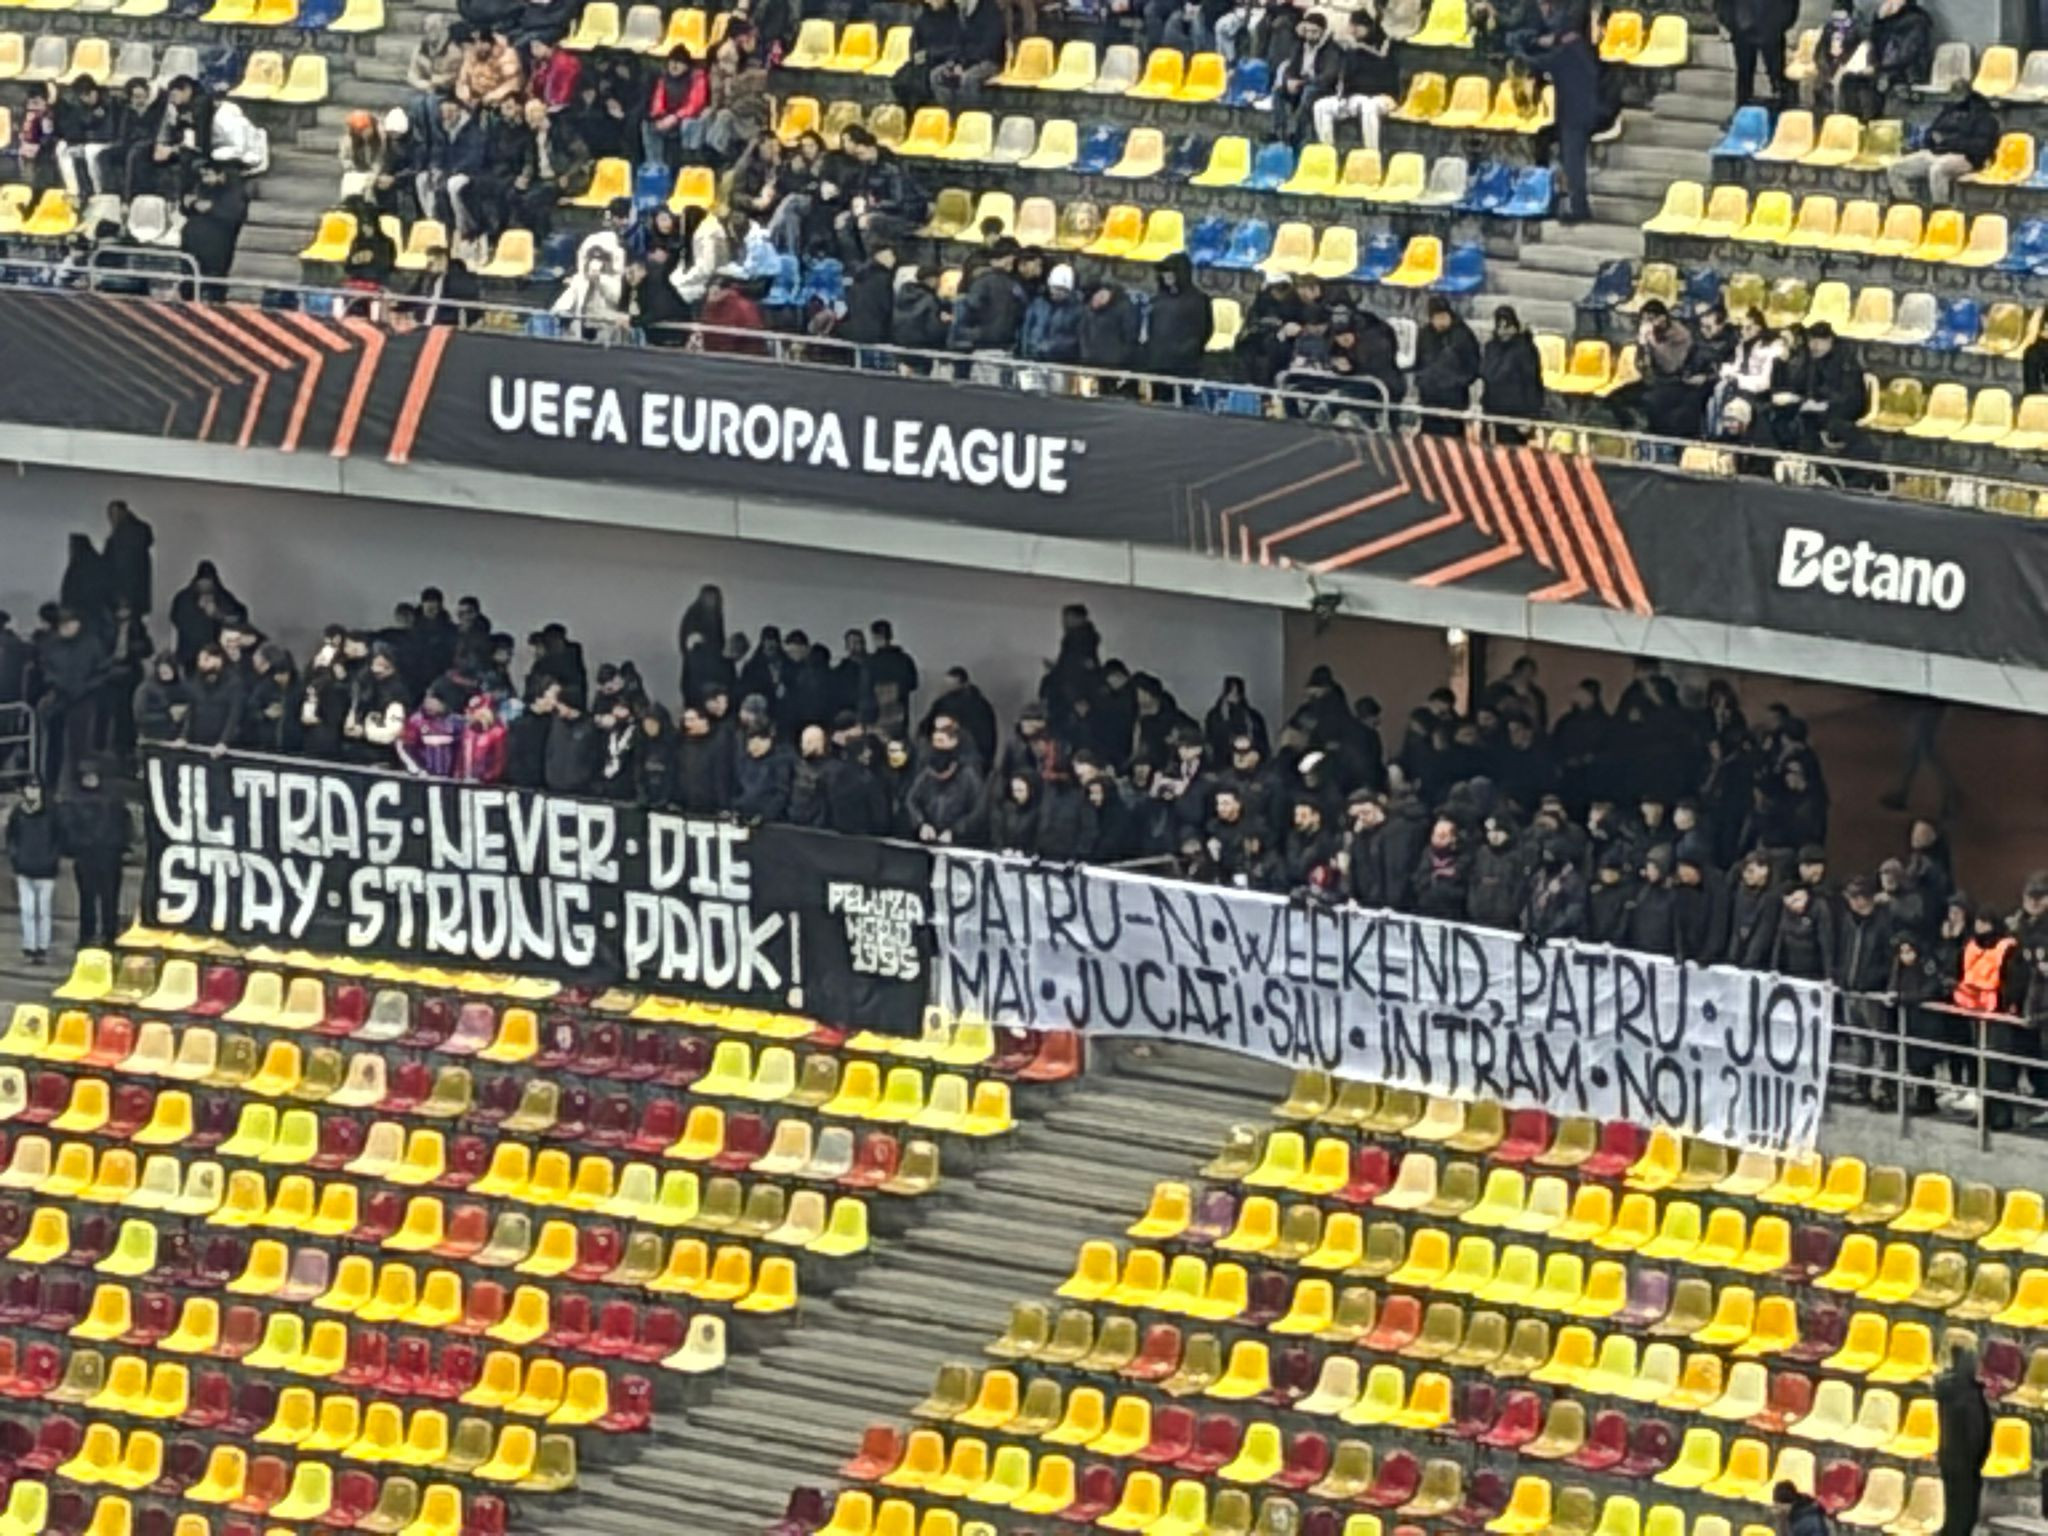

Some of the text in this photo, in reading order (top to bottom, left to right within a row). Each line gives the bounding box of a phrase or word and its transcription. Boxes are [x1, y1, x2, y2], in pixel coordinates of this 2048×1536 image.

[490, 375, 1069, 493] UEFA EUROPA LEAGUE
[1777, 527, 1966, 611] Betano
[147, 758, 751, 899] ULTRAS NEVER DIE
[157, 846, 804, 1009] STAY STRONG PAOK!
[1263, 977, 1341, 1070] SAU
